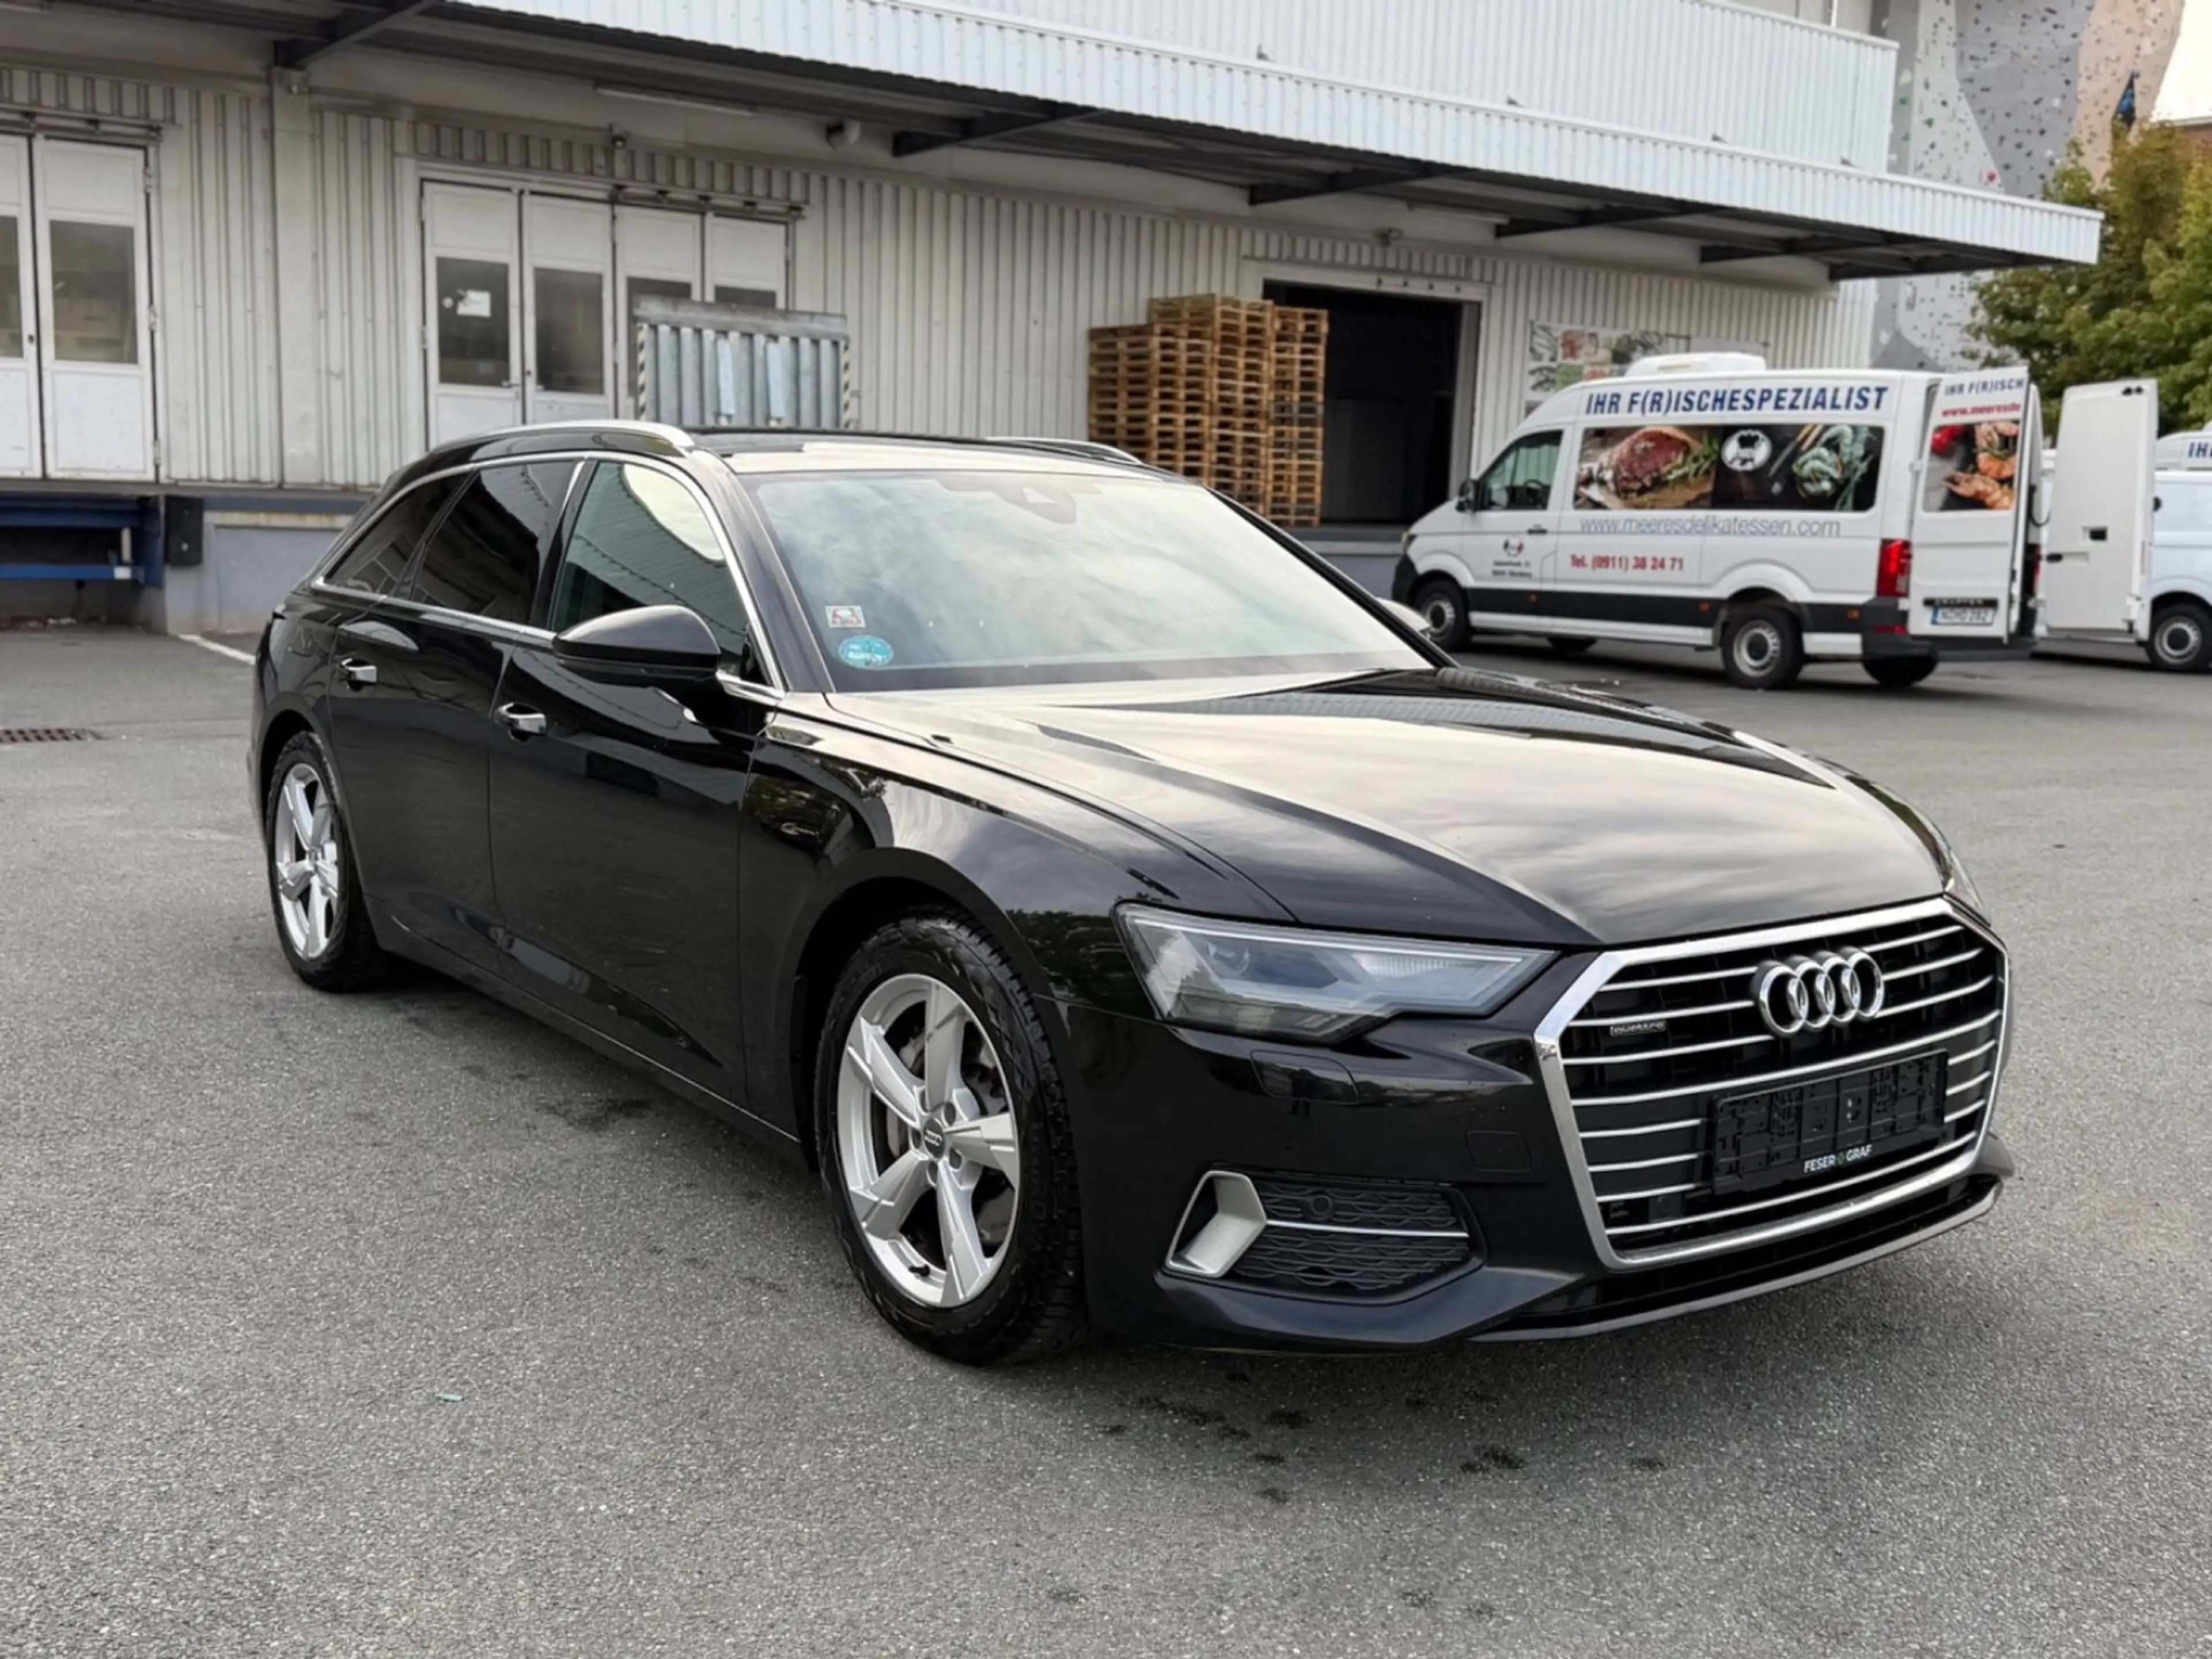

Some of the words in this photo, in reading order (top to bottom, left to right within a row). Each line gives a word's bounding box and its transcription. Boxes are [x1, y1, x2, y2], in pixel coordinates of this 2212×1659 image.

[1585, 392, 1622, 415] IHR
[1627, 386, 1889, 416] F(R)ISCHESPEZIALIST
[2188, 442, 2212, 459] IH
[1580, 515, 1842, 538] www.meeresdelikatessen.com
[1570, 554, 1588, 569] Tel.
[1591, 554, 1630, 573] (0911)
[1633, 555, 1647, 570] 38
[1650, 555, 1666, 570] 24
[1669, 556, 1684, 571] 71
[1804, 1154, 1836, 1173] FESER
[1846, 1143, 1873, 1162] GRAF
